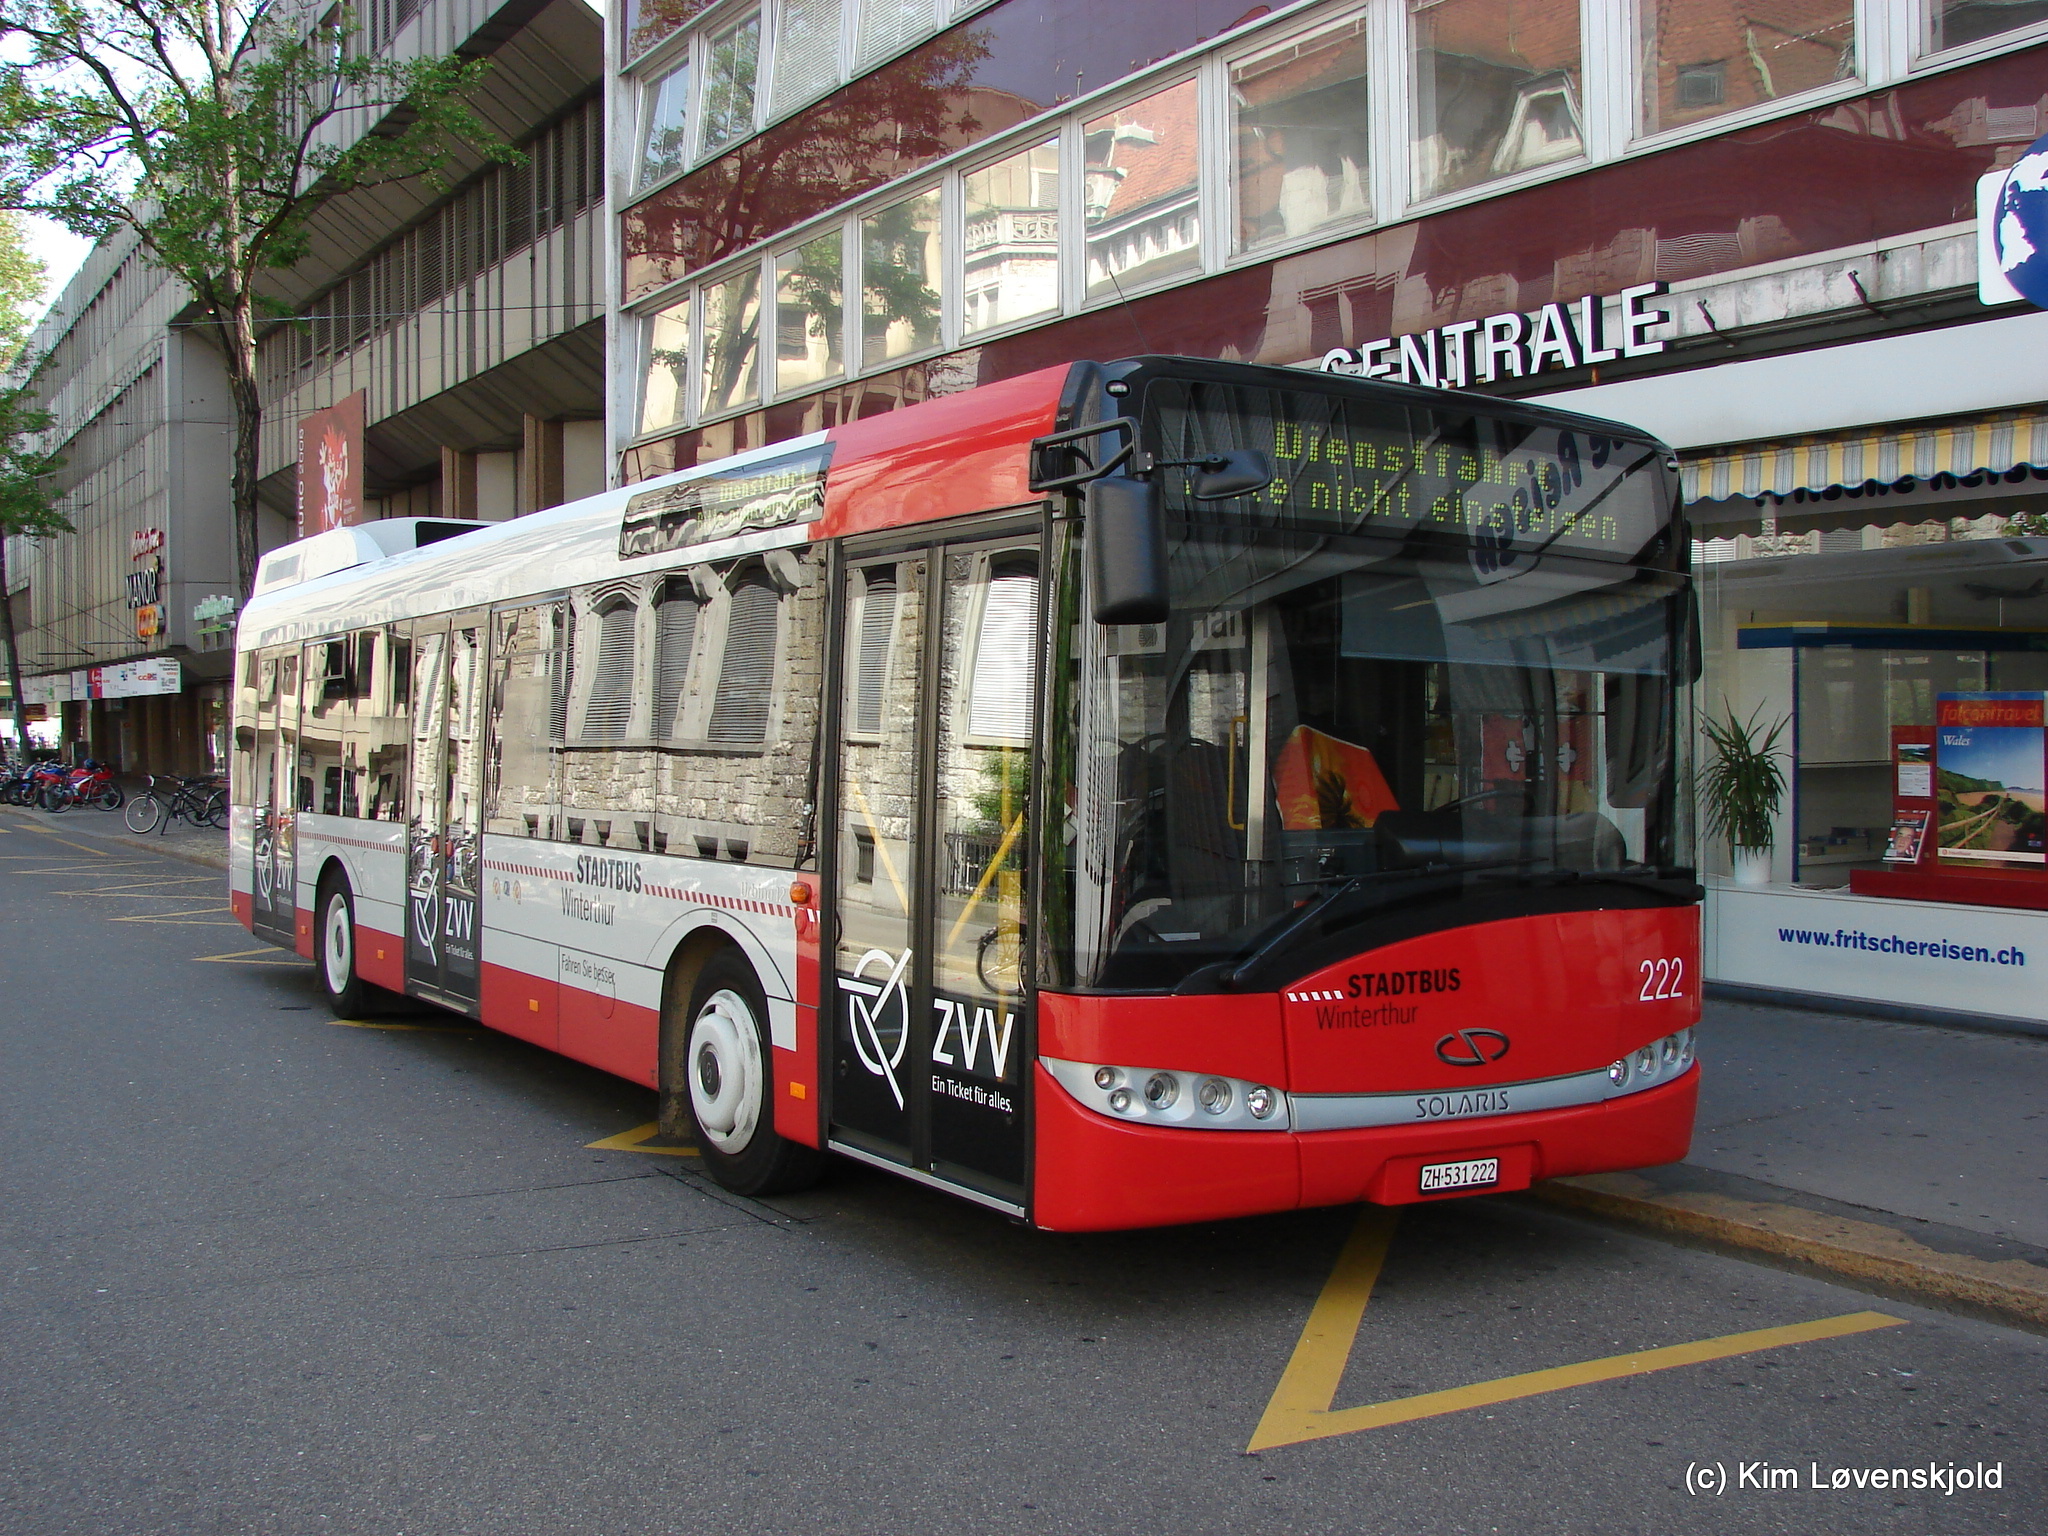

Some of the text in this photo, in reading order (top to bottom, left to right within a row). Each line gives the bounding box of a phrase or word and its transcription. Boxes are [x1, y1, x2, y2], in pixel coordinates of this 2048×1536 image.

[1274, 421, 1550, 491] Dienstfahrt
[1310, 475, 1411, 518] nicht
[1943, 734, 1971, 746] Wales
[577, 854, 642, 894] STADTBUS
[445, 896, 474, 941] ZVV
[561, 886, 616, 926] Winterthur
[561, 953, 582, 975] Fahren
[582, 959, 593, 979] Sie
[1778, 926, 2025, 967] www.fritschereisen.ch
[1347, 968, 1461, 999] STADTBUS
[1640, 957, 1684, 1001] 222
[1316, 1003, 1418, 1030] Winterthur
[932, 998, 1015, 1078] ZVV
[932, 1075, 1013, 1113] Ein Ticket für alles.
[1416, 1090, 1509, 1118] SOLARIS
